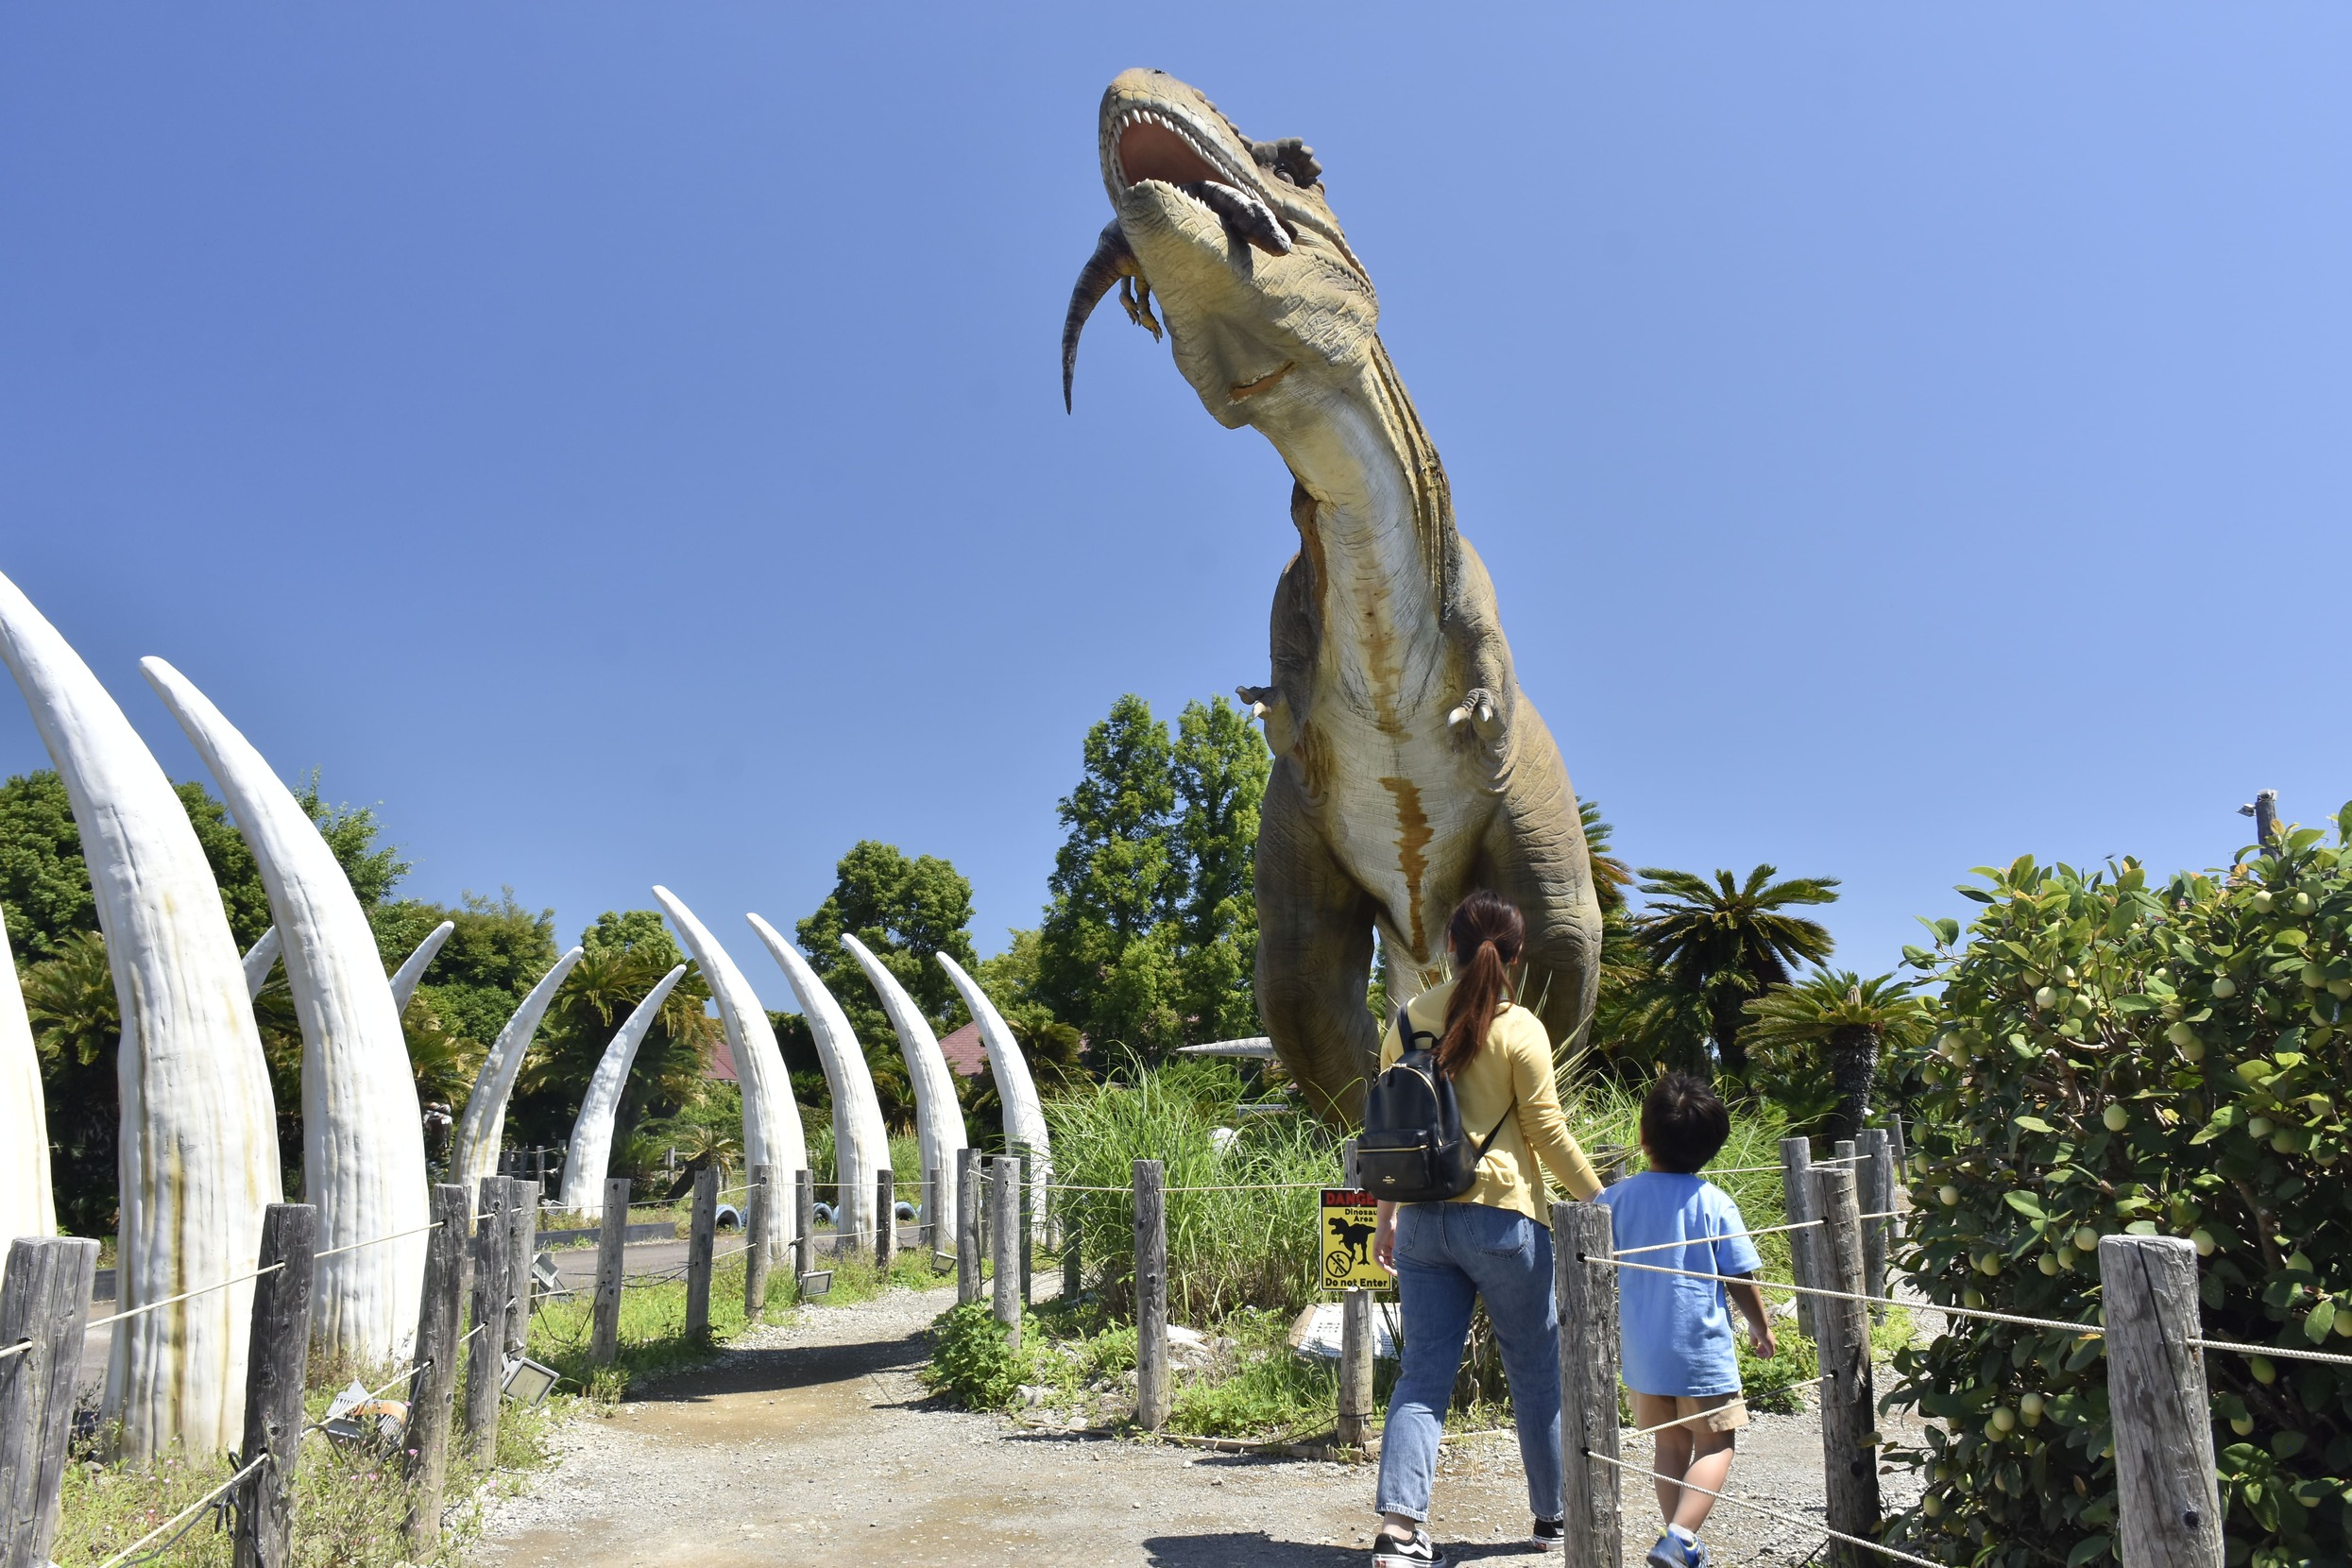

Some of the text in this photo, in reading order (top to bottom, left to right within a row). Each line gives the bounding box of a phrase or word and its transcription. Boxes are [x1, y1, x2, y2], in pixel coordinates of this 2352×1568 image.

[1326, 1192, 1377, 1205] DANGE
[1325, 1278, 1338, 1287] Do
[1360, 1278, 1388, 1287] Enter
